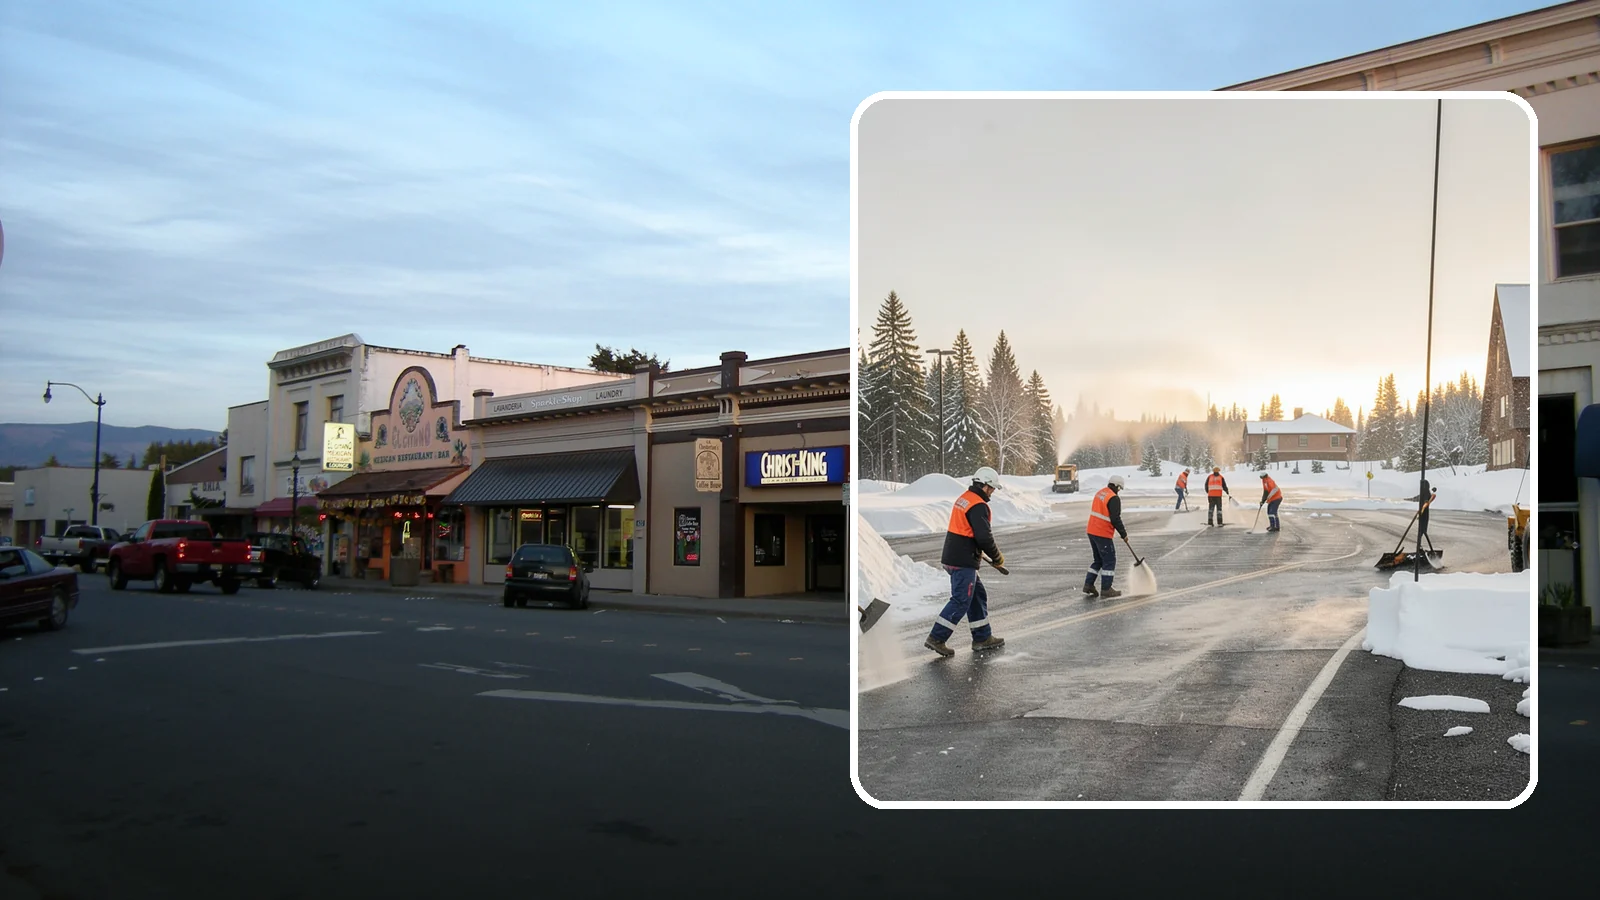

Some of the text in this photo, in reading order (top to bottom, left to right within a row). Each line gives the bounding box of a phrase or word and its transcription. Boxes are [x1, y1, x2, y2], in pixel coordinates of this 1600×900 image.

[531, 394, 582, 409] Sparkle Shop
[595, 389, 623, 400] LAUNDRY
[493, 402, 522, 412] LAVANDERIA
[373, 454, 396, 464] MEXICAN
[397, 452, 433, 462] RESTAURANT
[437, 450, 450, 459] BAR
[761, 450, 828, 478] CHRIST KING
